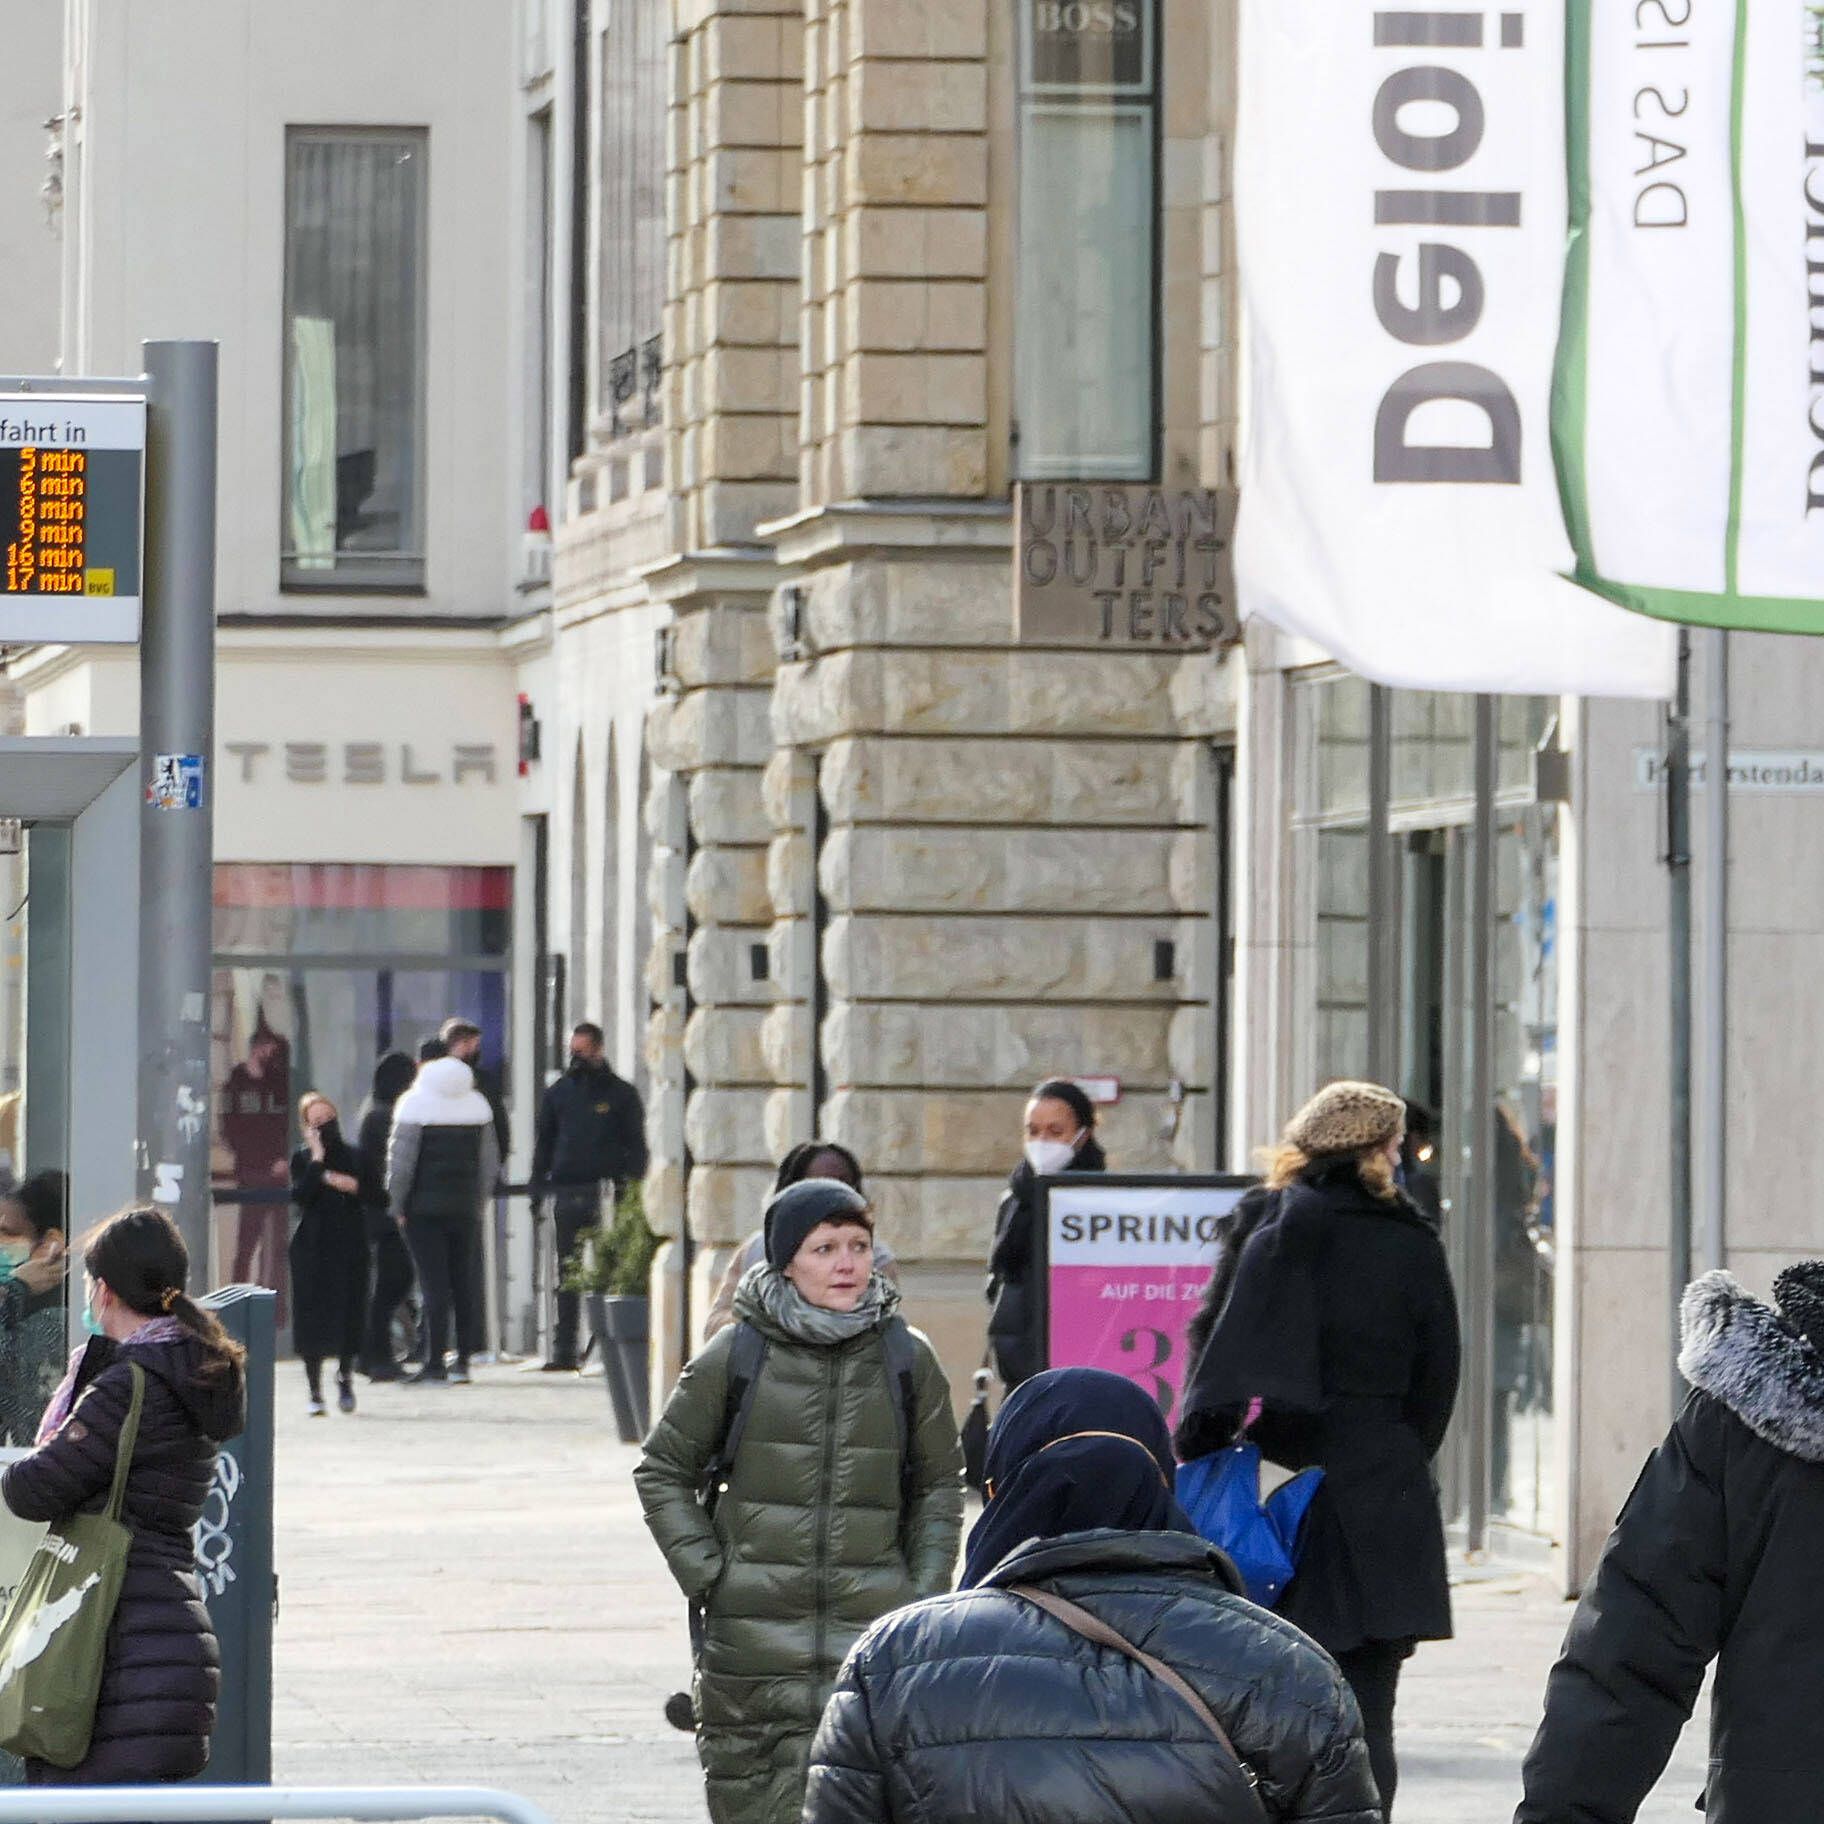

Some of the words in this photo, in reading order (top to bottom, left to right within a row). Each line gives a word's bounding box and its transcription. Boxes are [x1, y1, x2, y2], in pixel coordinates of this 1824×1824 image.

[66, 420, 87, 442] in
[20, 447, 36, 472] 5
[40, 449, 85, 472] min
[20, 472, 36, 495] 6
[40, 473, 84, 495] min
[20, 496, 35, 518] 8
[40, 497, 84, 519] min
[1023, 487, 1217, 541] URBAN
[20, 519, 35, 543] 9
[40, 521, 83, 543] min
[7, 543, 35, 567] 16
[39, 545, 83, 568] min
[1024, 539, 1224, 589] OUTFIT
[7, 567, 35, 592] 17
[39, 569, 83, 592] min
[88, 582, 110, 595] BVG
[1093, 592, 1223, 641] TERS
[225, 741, 497, 786] TESLA
[1101, 1283, 1140, 1300] AUF
[1145, 1284, 1176, 1300] DIE
